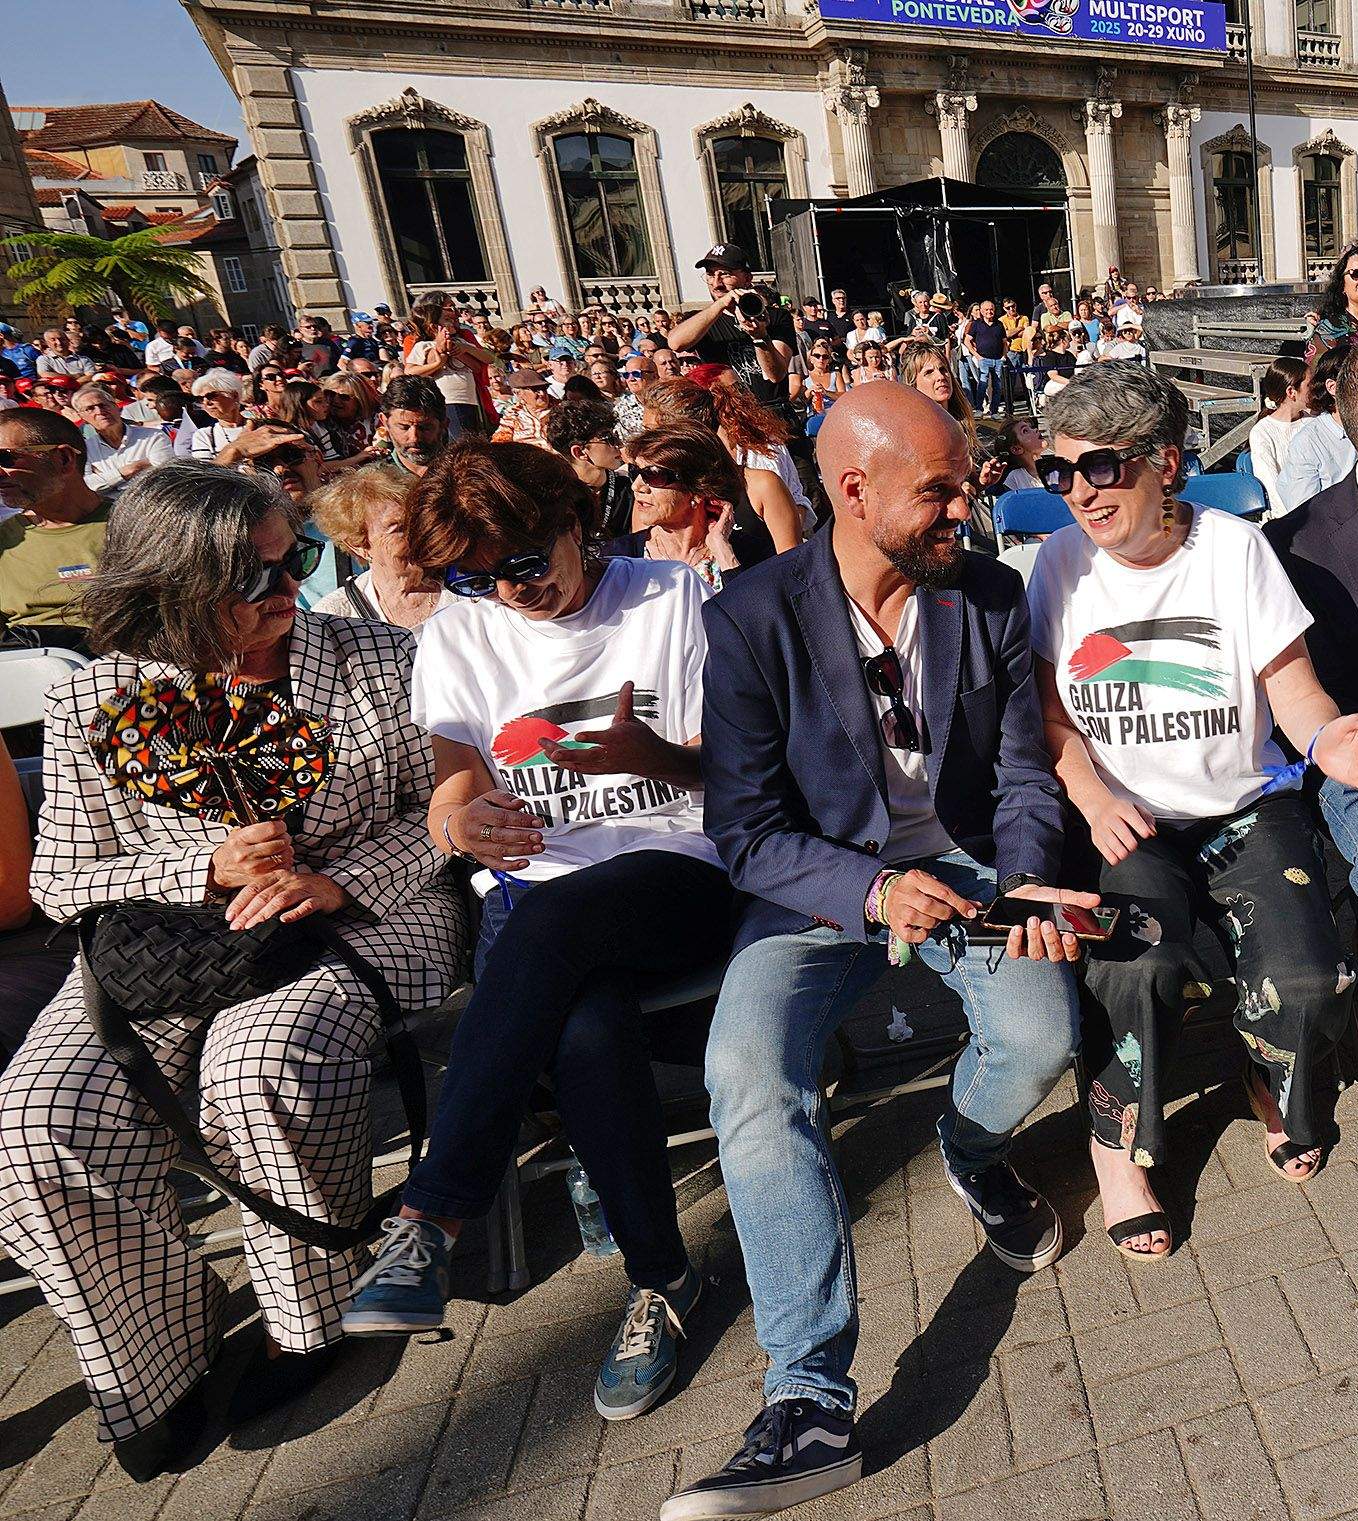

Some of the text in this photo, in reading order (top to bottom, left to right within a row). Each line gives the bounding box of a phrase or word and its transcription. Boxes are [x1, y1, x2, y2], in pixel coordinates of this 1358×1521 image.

[892, 1, 1020, 26] PONTEVEDRA
[1089, 0, 1205, 27] MULTISPORT
[1090, 20, 1206, 43] 2025 20-29 XUÑO
[1069, 681, 1143, 713] GALIZA
[1077, 706, 1241, 745] CON PALESTINA
[499, 766, 587, 797] GALIZA
[521, 799, 554, 829] ON
